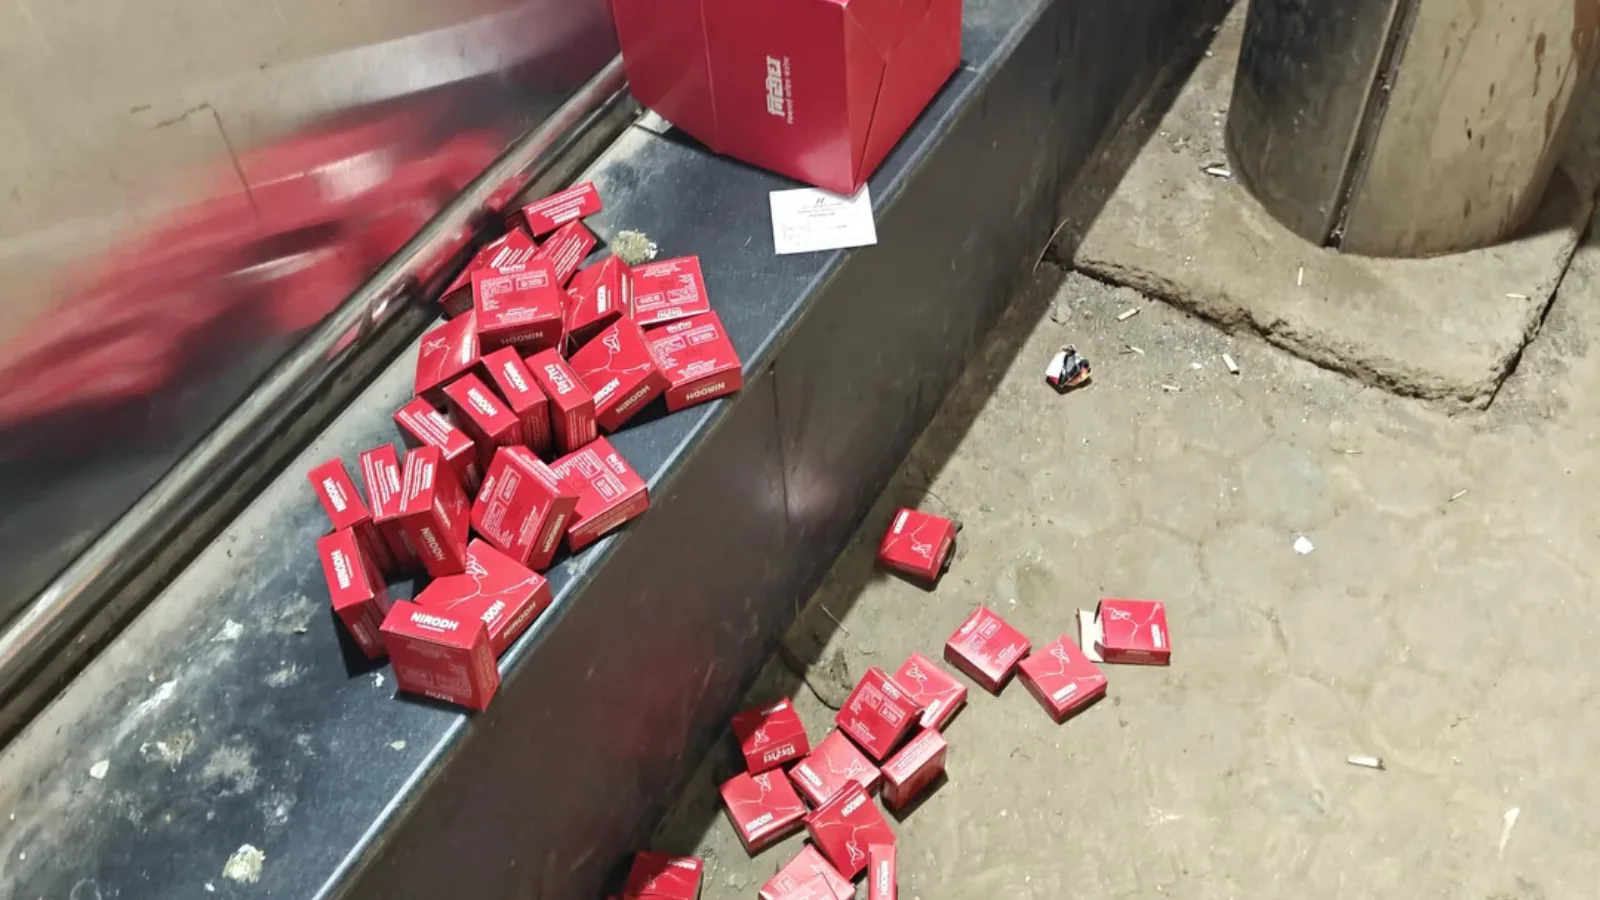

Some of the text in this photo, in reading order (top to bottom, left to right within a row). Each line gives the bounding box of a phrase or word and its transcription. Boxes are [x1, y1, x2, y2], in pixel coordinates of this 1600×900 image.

[615, 385, 651, 414] NIRODH
[686, 381, 726, 402] NIRODH
[322, 477, 346, 513] NIRODH
[420, 526, 446, 562] NIRODH
[331, 549, 351, 589] NIRODH
[410, 612, 459, 631] NIRODH
